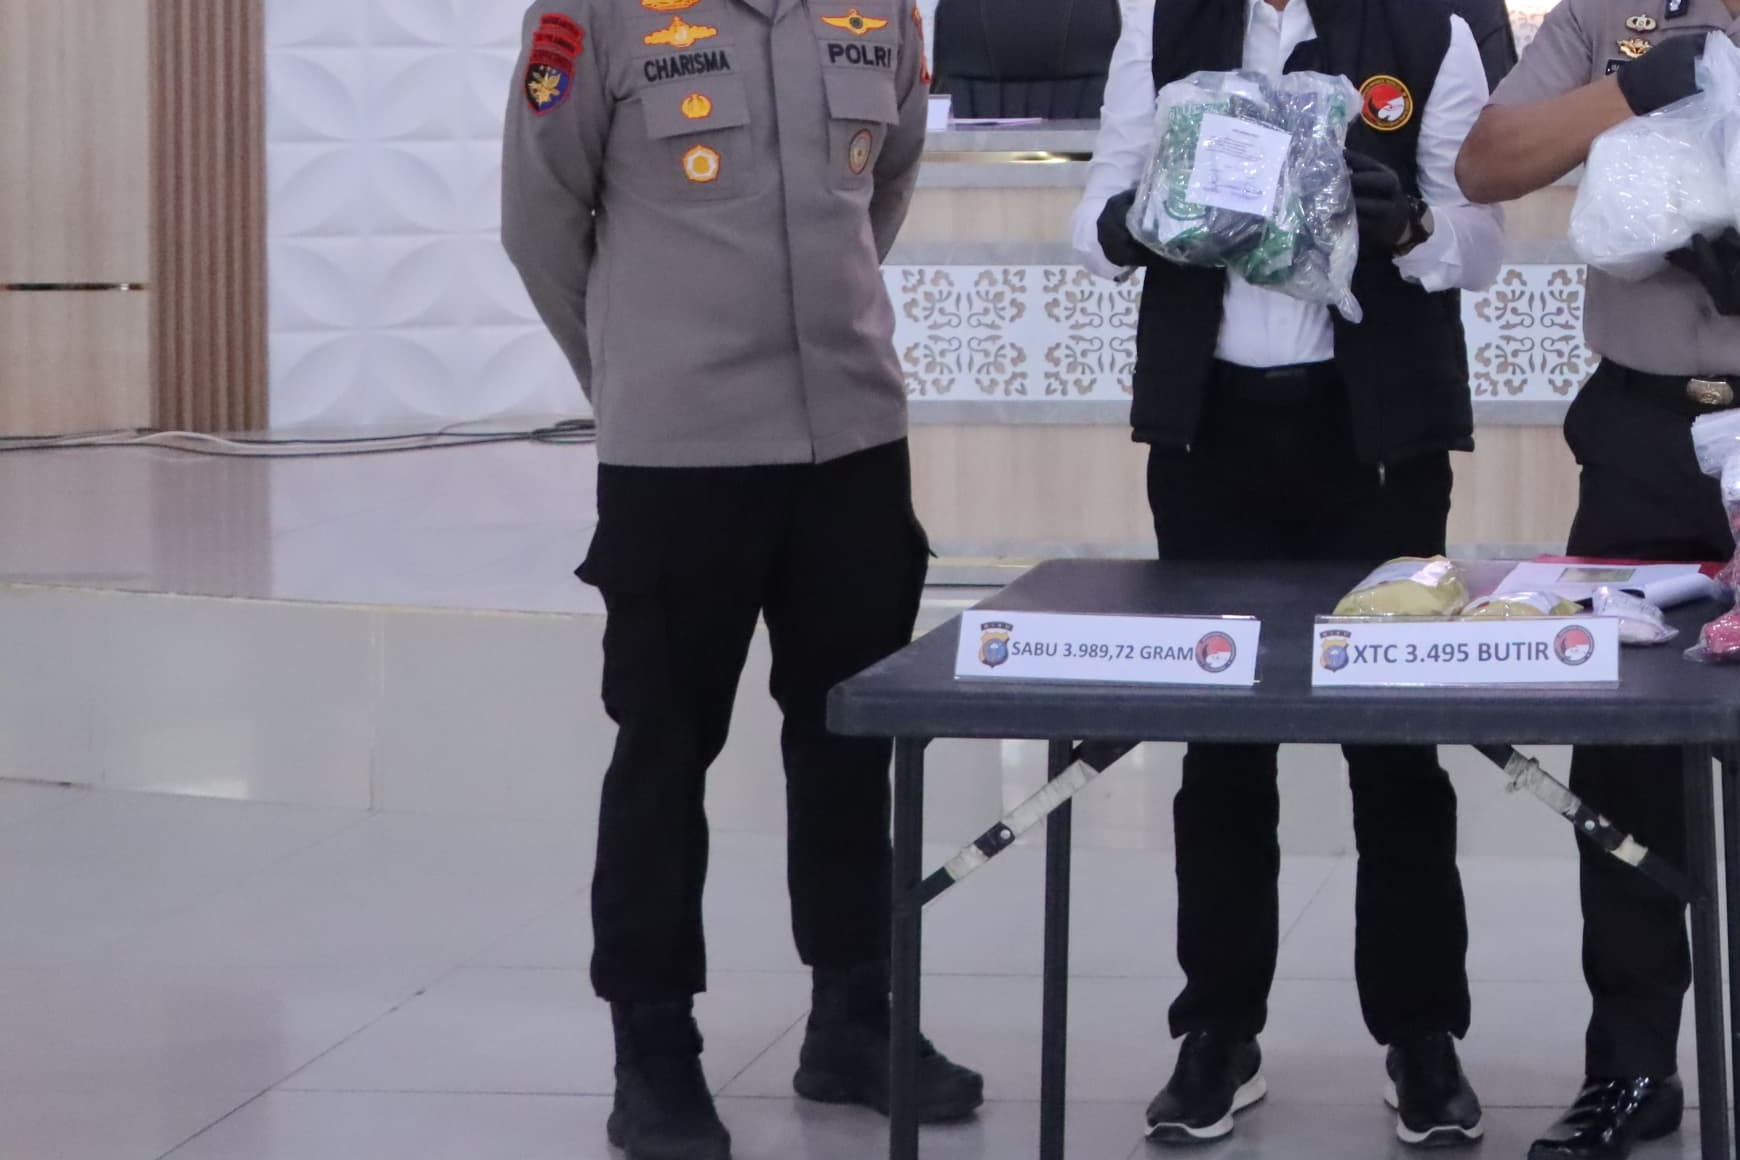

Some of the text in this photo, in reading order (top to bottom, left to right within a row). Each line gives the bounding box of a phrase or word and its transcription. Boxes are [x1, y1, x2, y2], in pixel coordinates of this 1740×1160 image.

[643, 50, 731, 83] CHARISMA
[827, 43, 892, 68] POLRI
[1011, 641, 1194, 661] SABU 3.989,72 GRAM
[1353, 644, 1398, 664] XTC
[1405, 643, 1470, 663] 3.495
[1477, 641, 1549, 662] BUTIR
